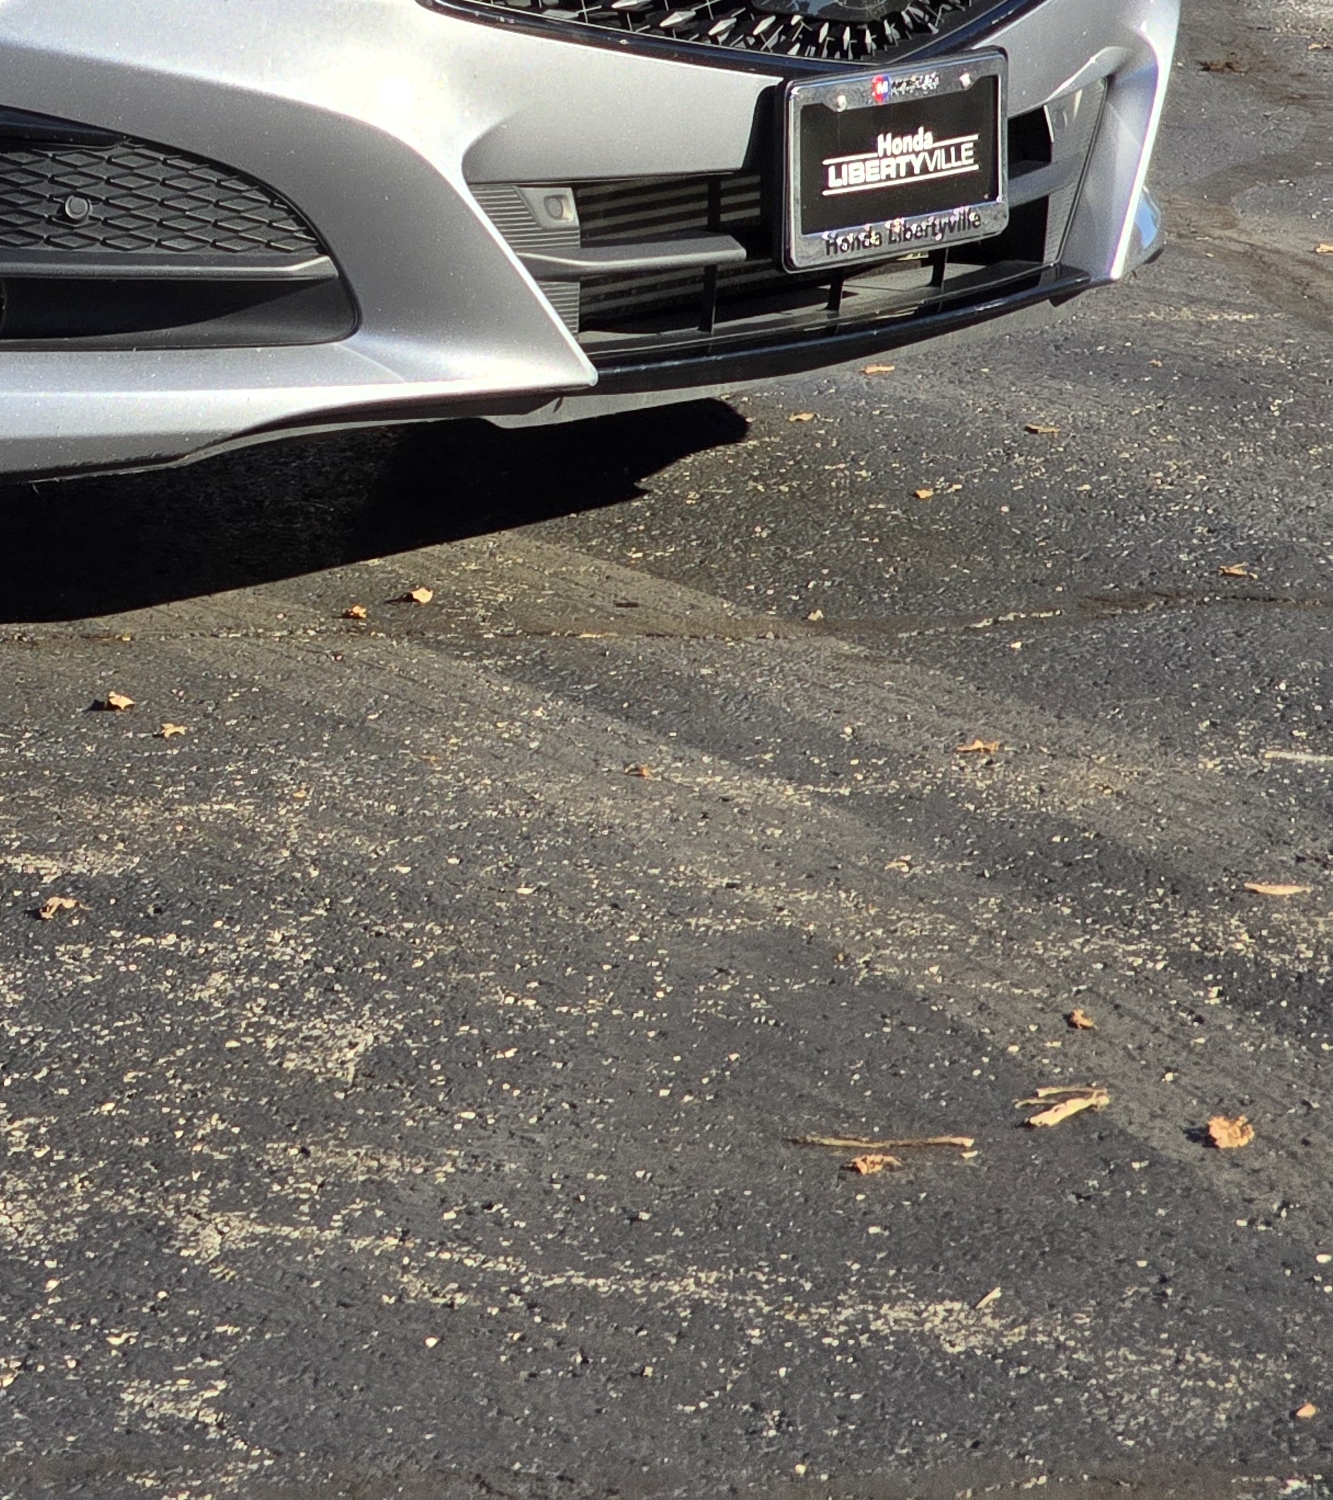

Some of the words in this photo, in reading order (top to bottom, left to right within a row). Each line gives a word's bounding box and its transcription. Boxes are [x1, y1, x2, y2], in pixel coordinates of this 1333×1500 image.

[877, 126, 934, 157] Honda
[827, 142, 975, 188] LIBERTYVILLE
[824, 225, 883, 256] Honda
[888, 209, 982, 244] Libertyville
